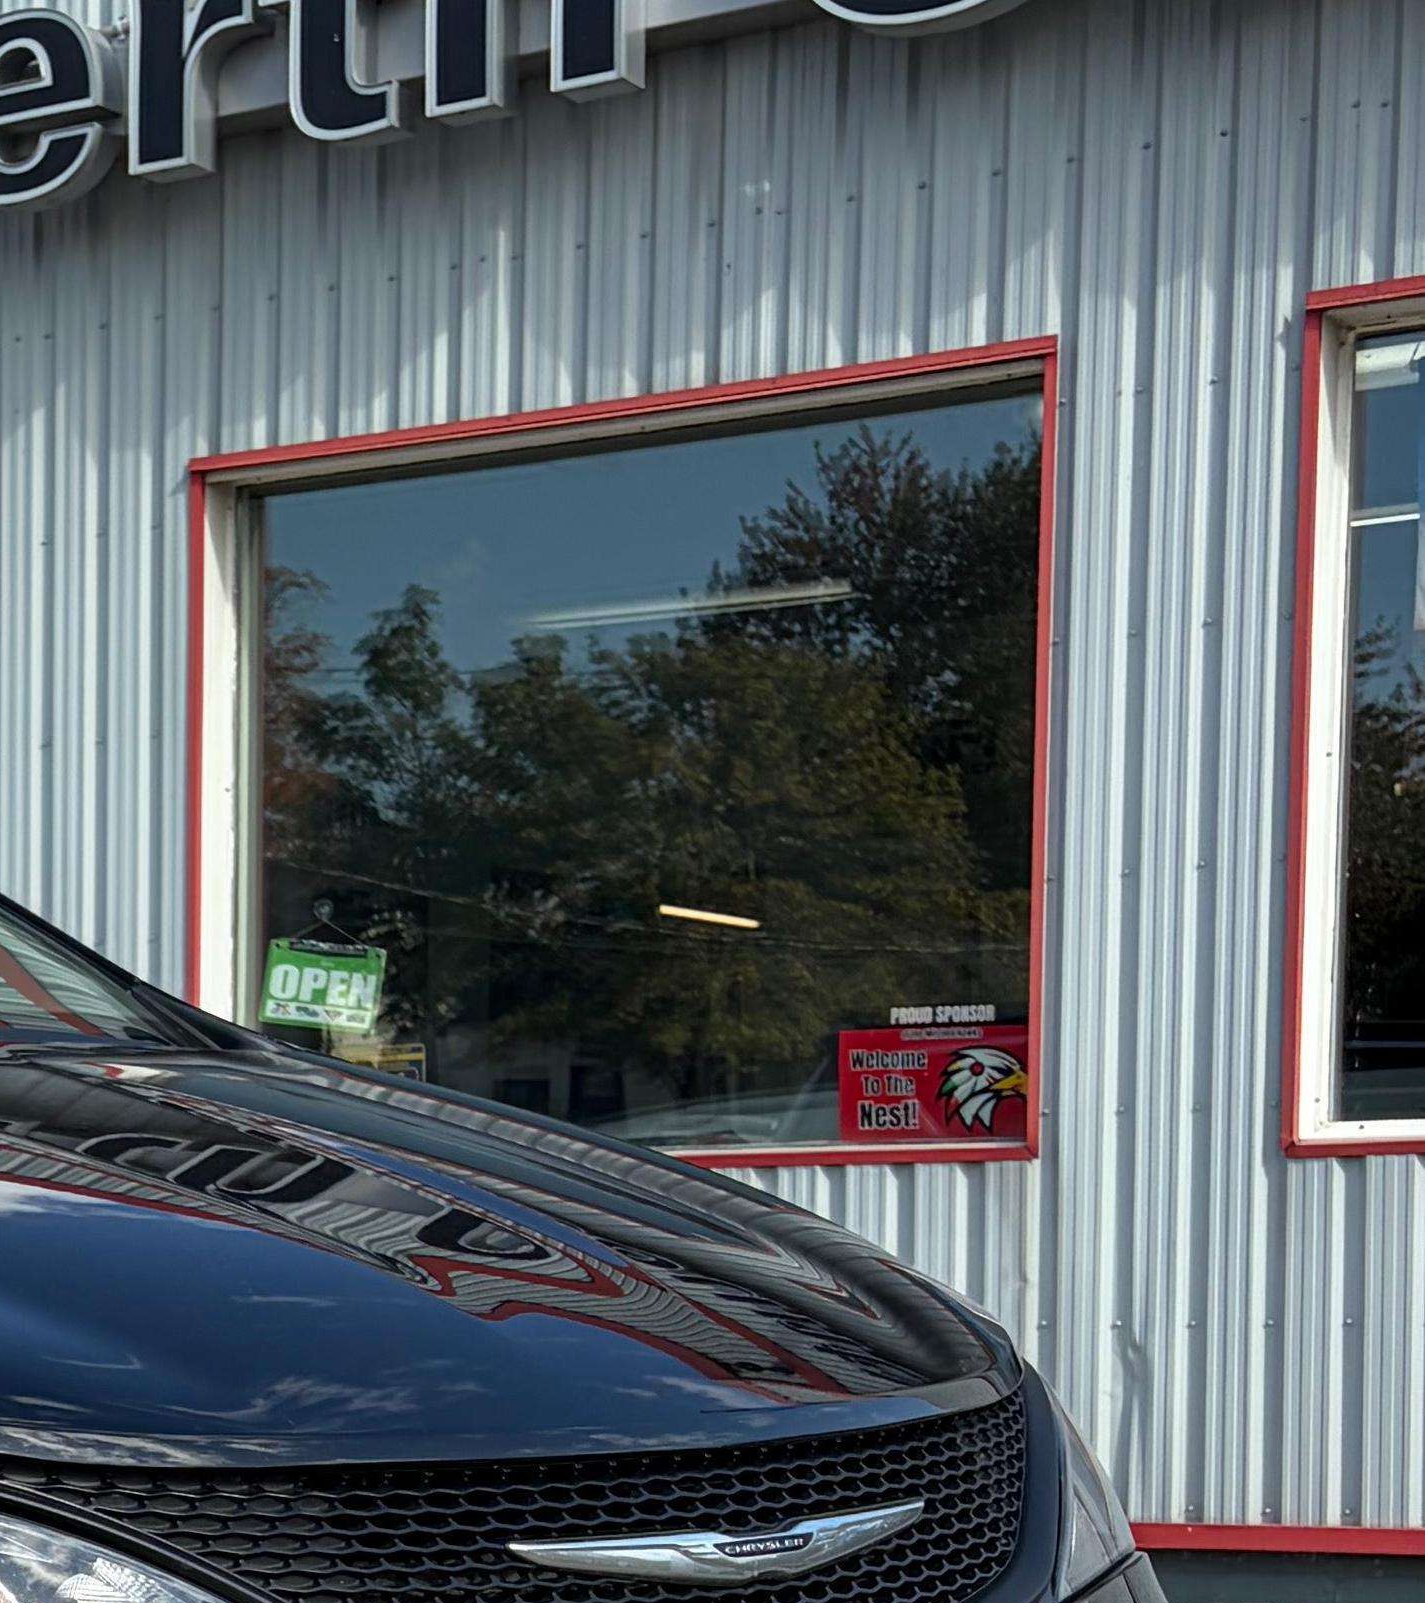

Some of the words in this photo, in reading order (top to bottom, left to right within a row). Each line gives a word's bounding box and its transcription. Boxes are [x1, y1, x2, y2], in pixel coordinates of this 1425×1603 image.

[269, 963, 377, 1009] OPEN
[890, 1006, 933, 1025] PROUD
[935, 1004, 996, 1023] SPONSOR
[851, 1050, 928, 1070] Welcome
[861, 1075, 880, 1096] To
[885, 1074, 915, 1096] The
[859, 1101, 919, 1130] Nest!
[724, 1537, 805, 1556] CHRYSLER
